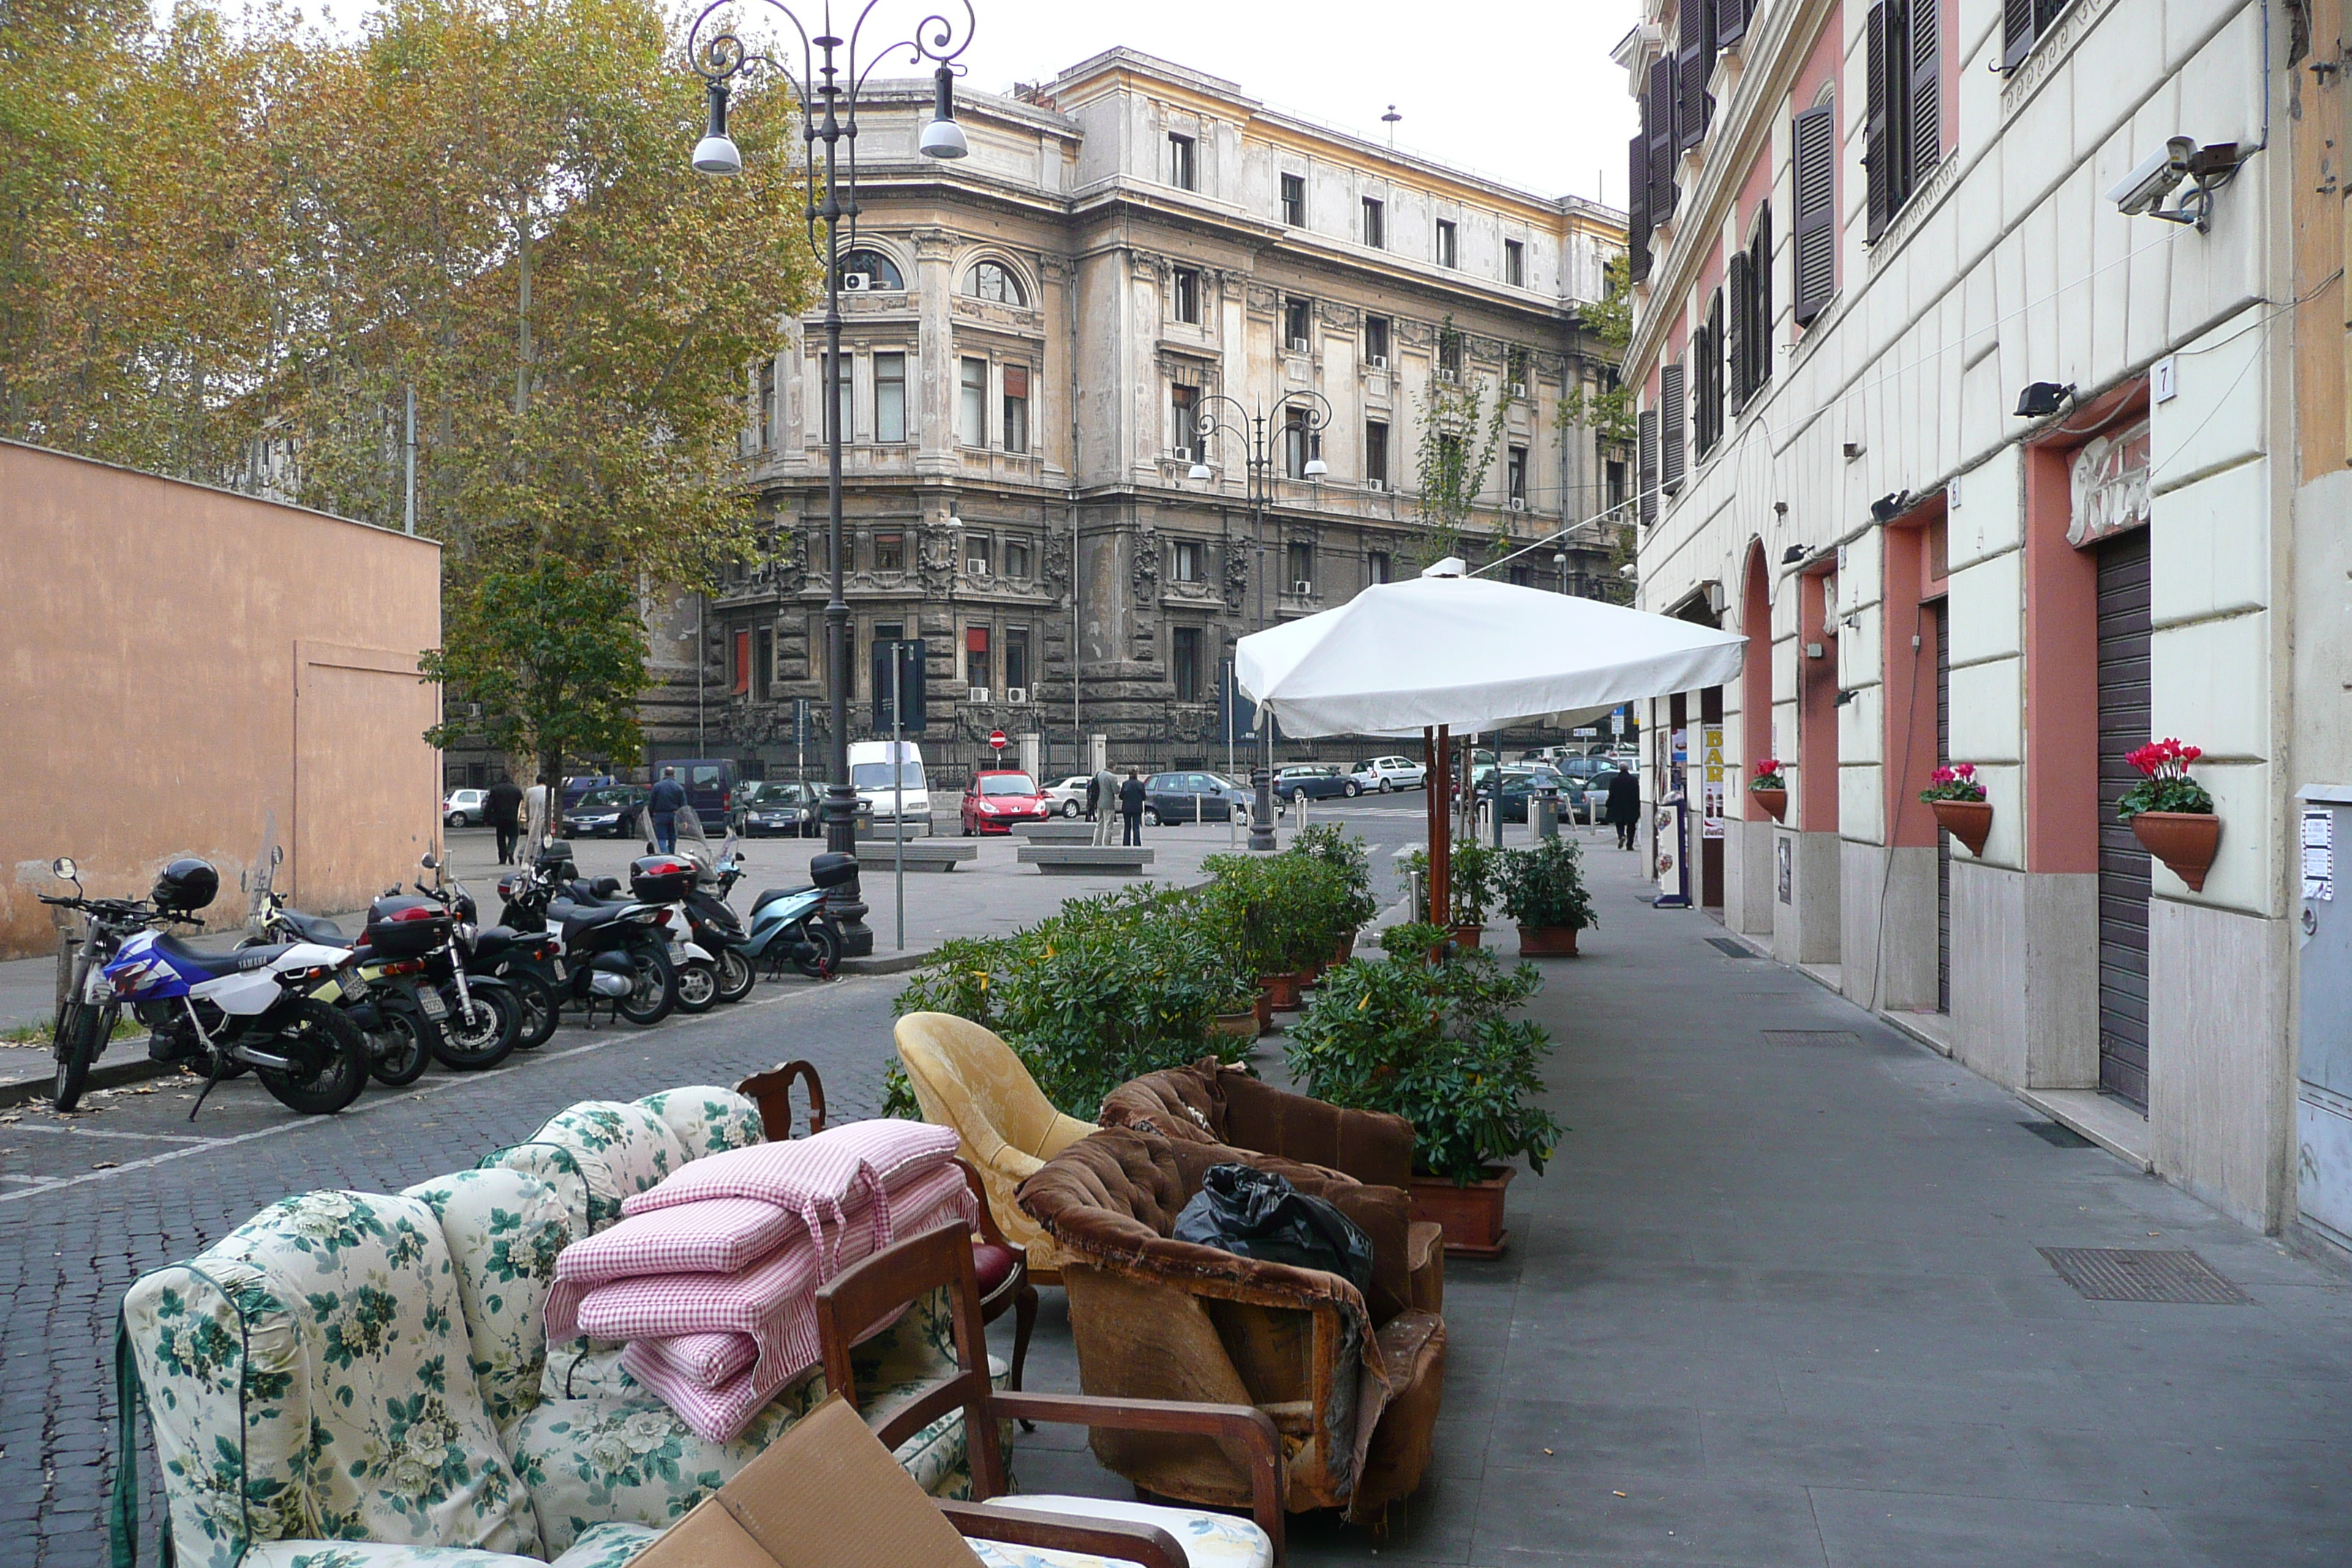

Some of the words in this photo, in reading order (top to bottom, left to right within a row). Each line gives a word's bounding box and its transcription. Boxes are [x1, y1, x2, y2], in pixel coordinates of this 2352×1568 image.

[2160, 366, 2168, 392] 7
[1705, 731, 1724, 783] BAR
[238, 955, 267, 970] YAMAHA
